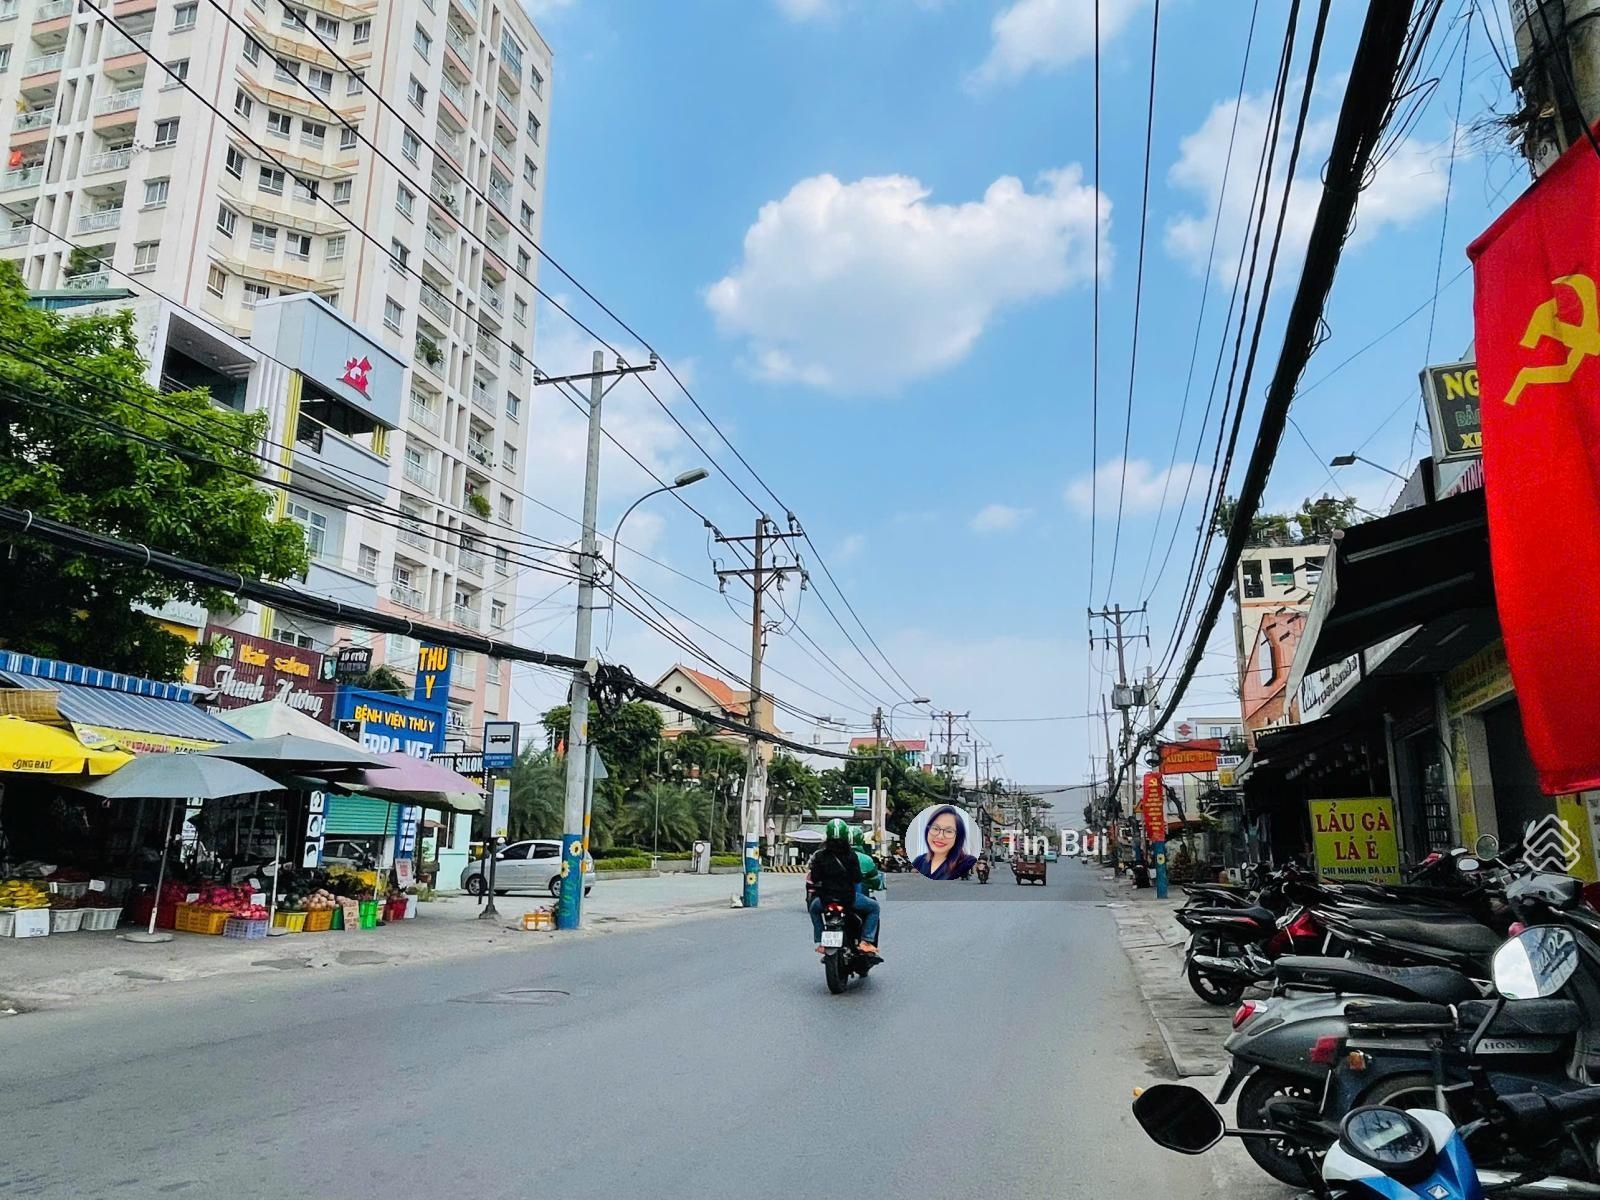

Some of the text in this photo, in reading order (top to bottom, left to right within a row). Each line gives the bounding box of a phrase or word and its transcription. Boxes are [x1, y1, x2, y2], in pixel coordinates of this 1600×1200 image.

[239, 644, 310, 677] Hair salon
[206, 664, 265, 702] Thanh
[424, 674, 436, 699] Y
[384, 711, 407, 730] VIỆN
[427, 721, 435, 733] Y
[405, 740, 434, 761] VET
[455, 757, 484, 773] SALON
[1315, 802, 1391, 833] LẨU GÀ
[1322, 867, 1336, 875] CHI
